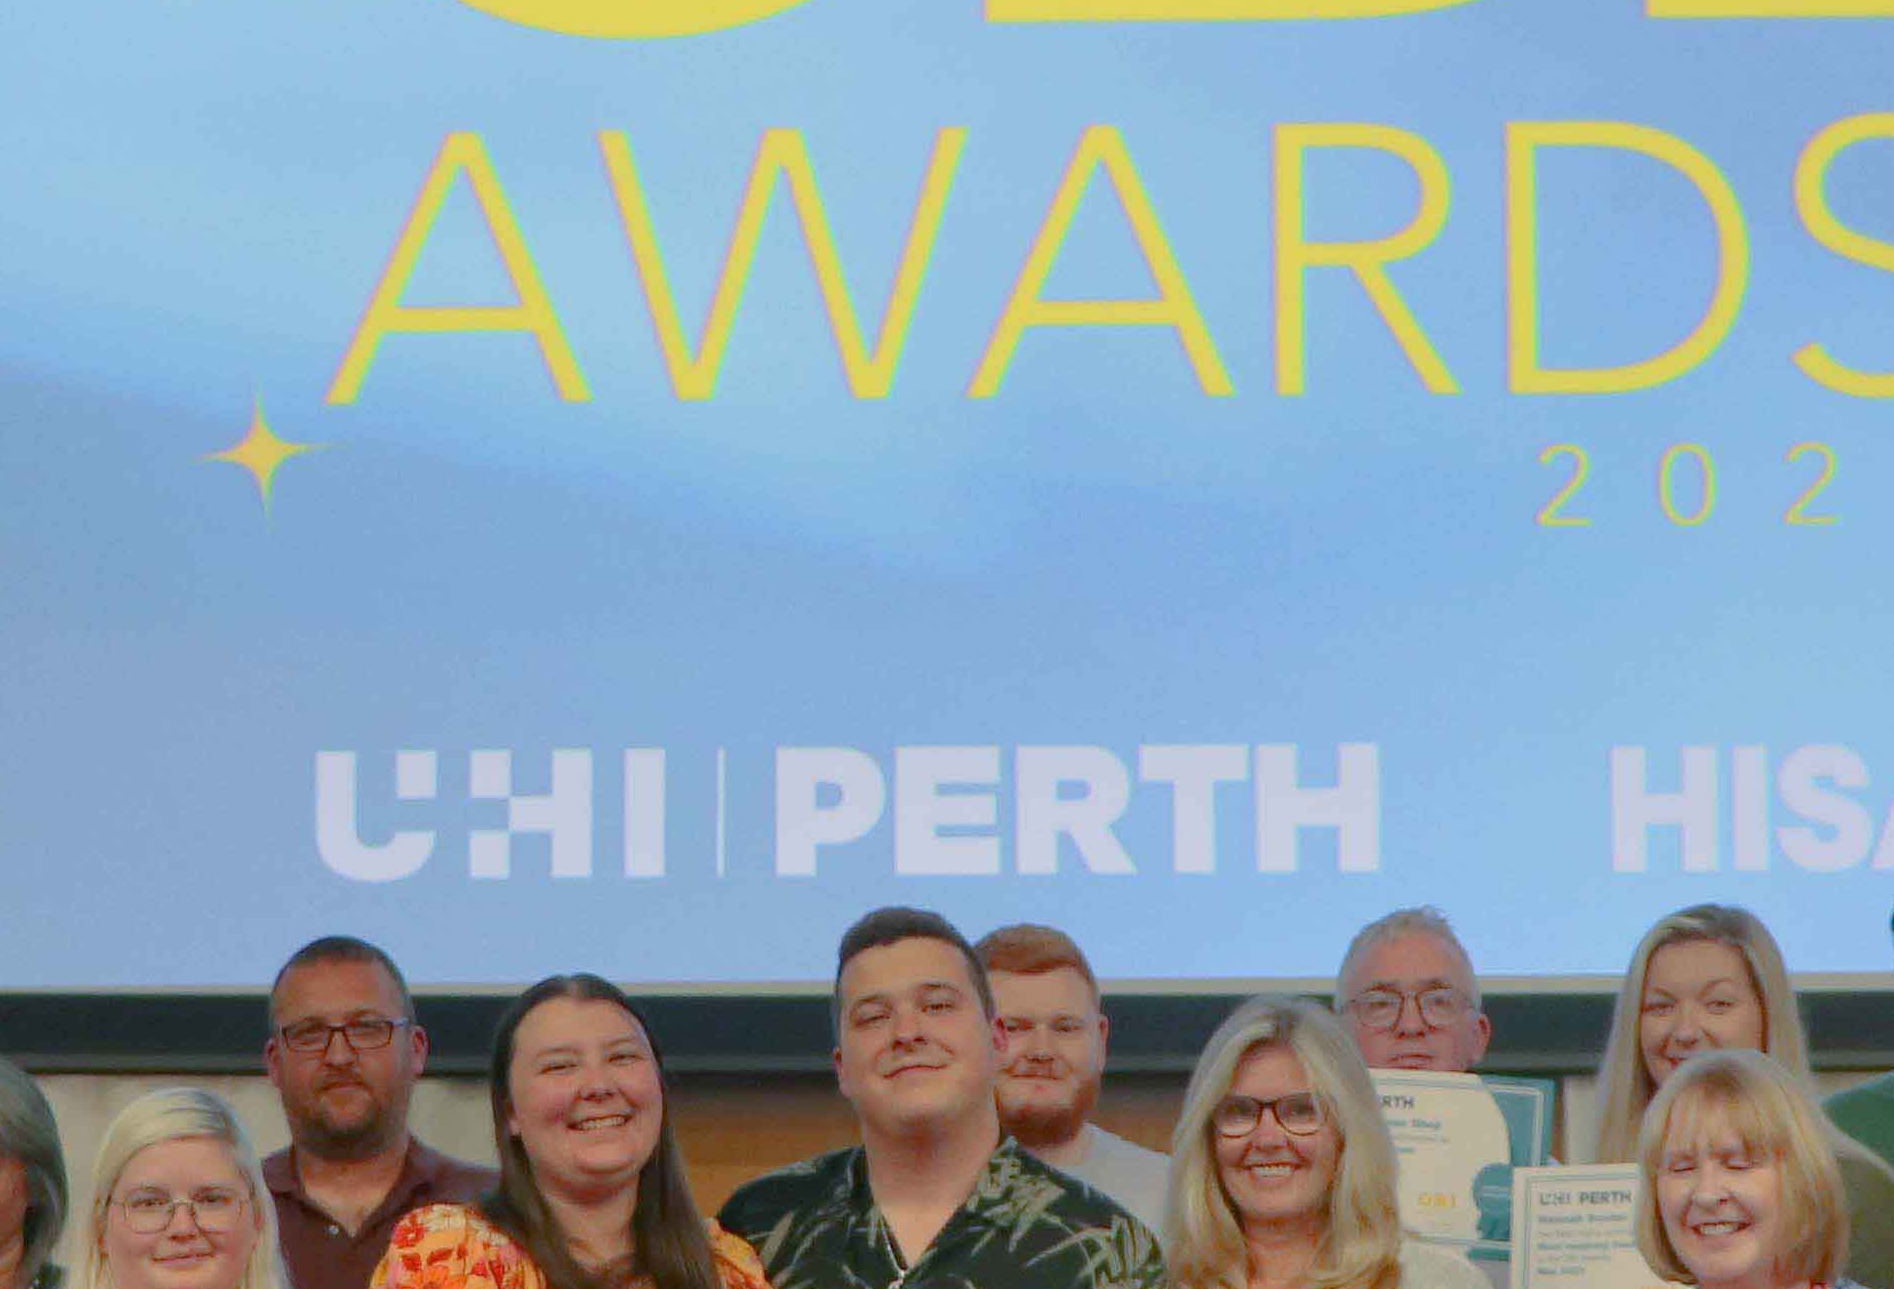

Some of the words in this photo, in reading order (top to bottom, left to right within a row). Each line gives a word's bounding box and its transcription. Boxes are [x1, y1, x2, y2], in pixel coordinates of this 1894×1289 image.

[313, 746, 665, 883] UHI
[775, 742, 1381, 878] PERTH
[1579, 1190, 1632, 1204] PERTH
